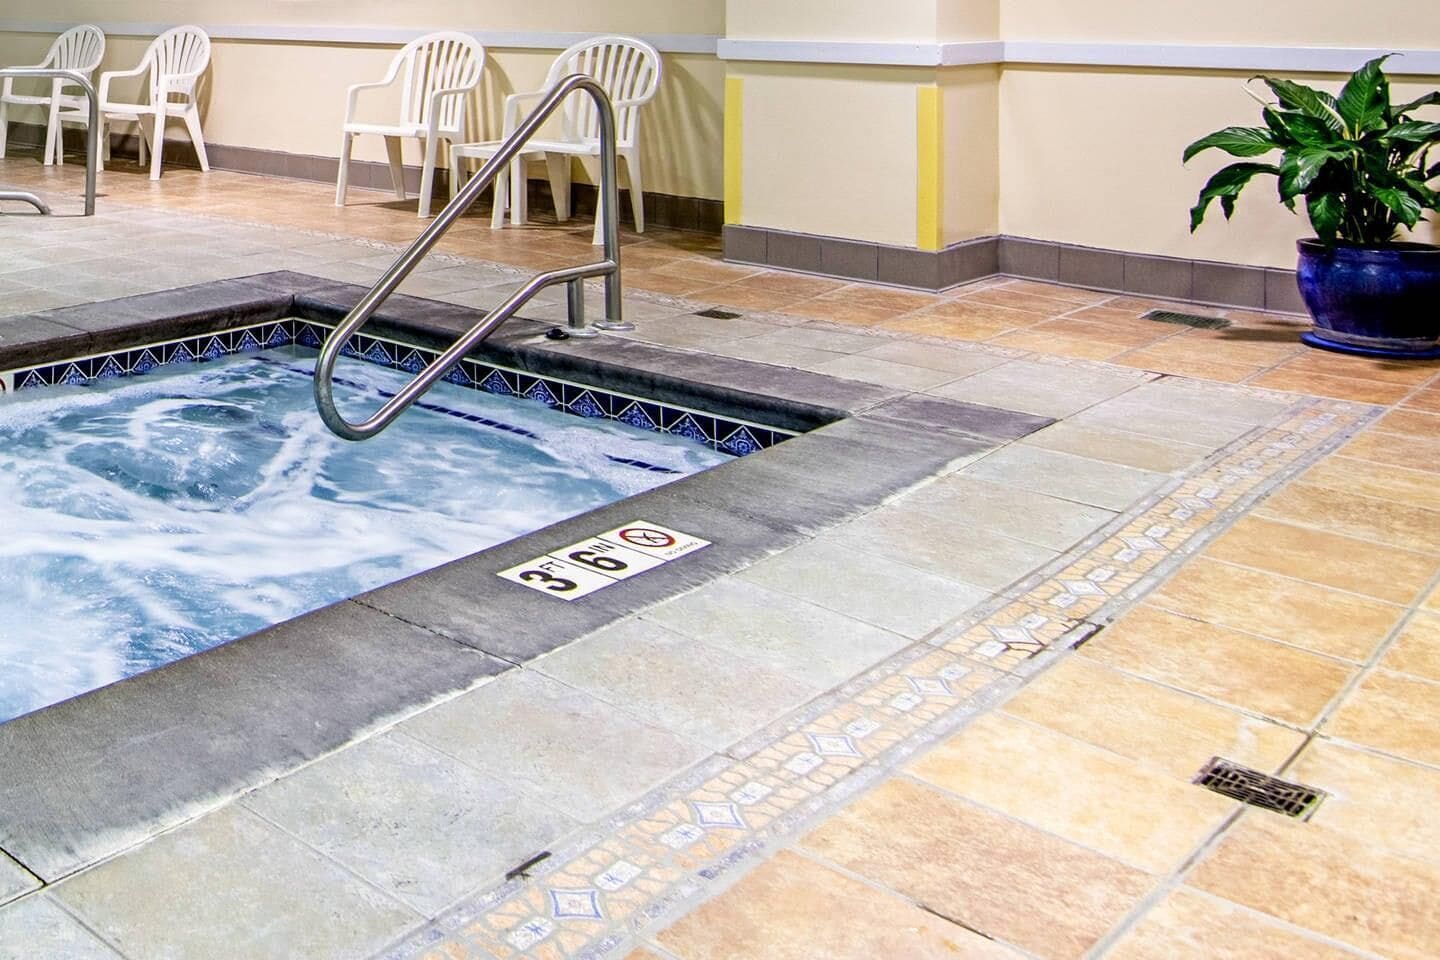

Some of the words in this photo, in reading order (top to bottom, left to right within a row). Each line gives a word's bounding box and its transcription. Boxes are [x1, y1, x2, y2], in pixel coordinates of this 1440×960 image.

[588, 542, 615, 554] IN
[539, 560, 566, 572] FT
[568, 551, 628, 572] 6
[519, 570, 578, 592] 3
